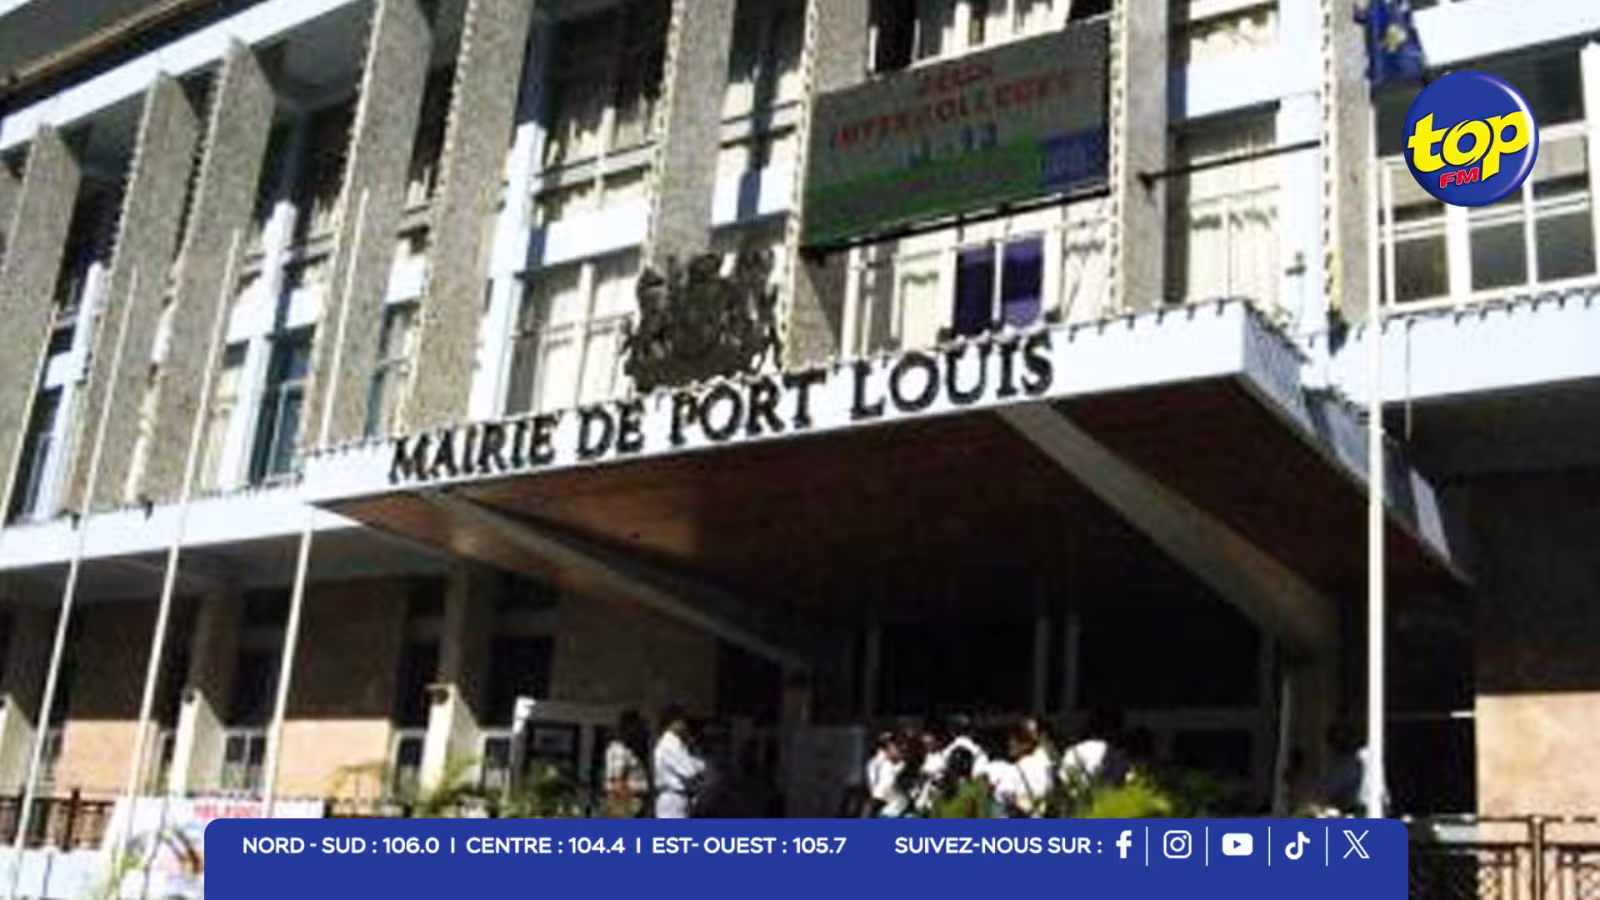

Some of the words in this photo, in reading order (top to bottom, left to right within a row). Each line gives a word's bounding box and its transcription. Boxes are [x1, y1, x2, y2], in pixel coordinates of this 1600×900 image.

[387, 412, 557, 484] MAIRIE
[576, 400, 645, 459] DE
[668, 370, 825, 446] PORT
[851, 331, 1053, 421] LOUIS
